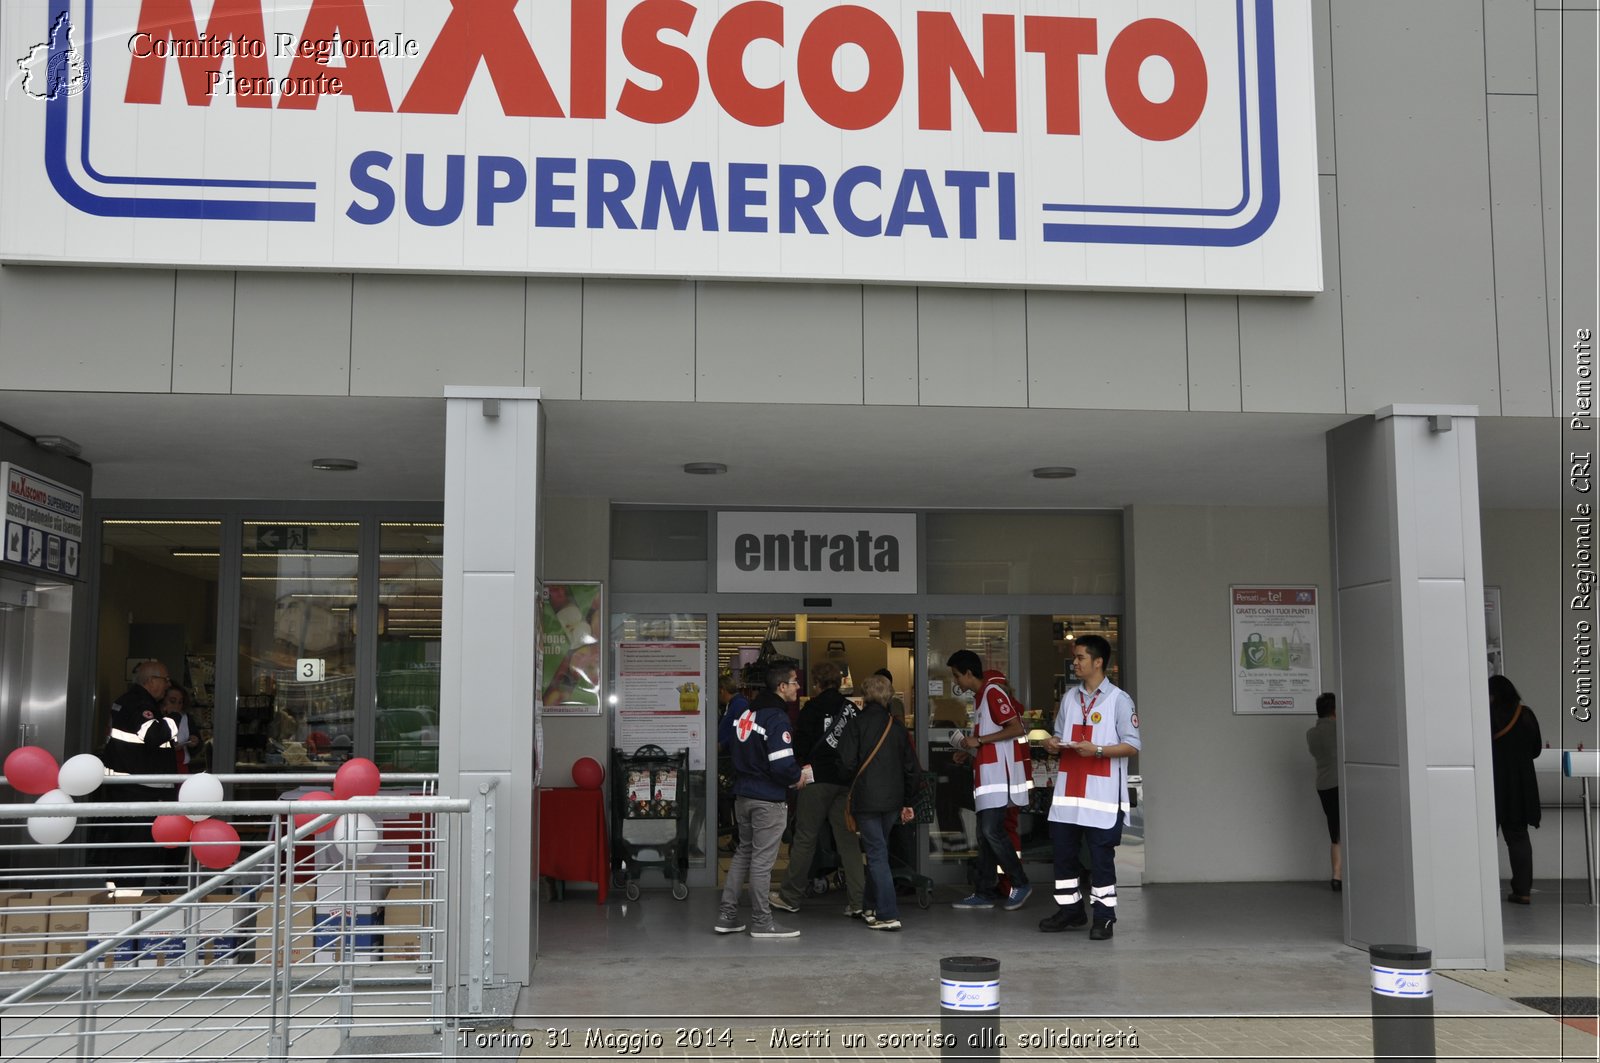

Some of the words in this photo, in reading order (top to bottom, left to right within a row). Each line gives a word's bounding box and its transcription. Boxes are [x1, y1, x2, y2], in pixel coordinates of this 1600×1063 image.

[124, 0, 1207, 141] MAXISCONTO
[347, 152, 1016, 240] SUPERMERCATI
[11, 476, 47, 504] MAXISCONTO
[48, 495, 80, 515] SUPERMERCATI
[735, 530, 900, 572] entrata
[303, 663, 314, 678] 3
